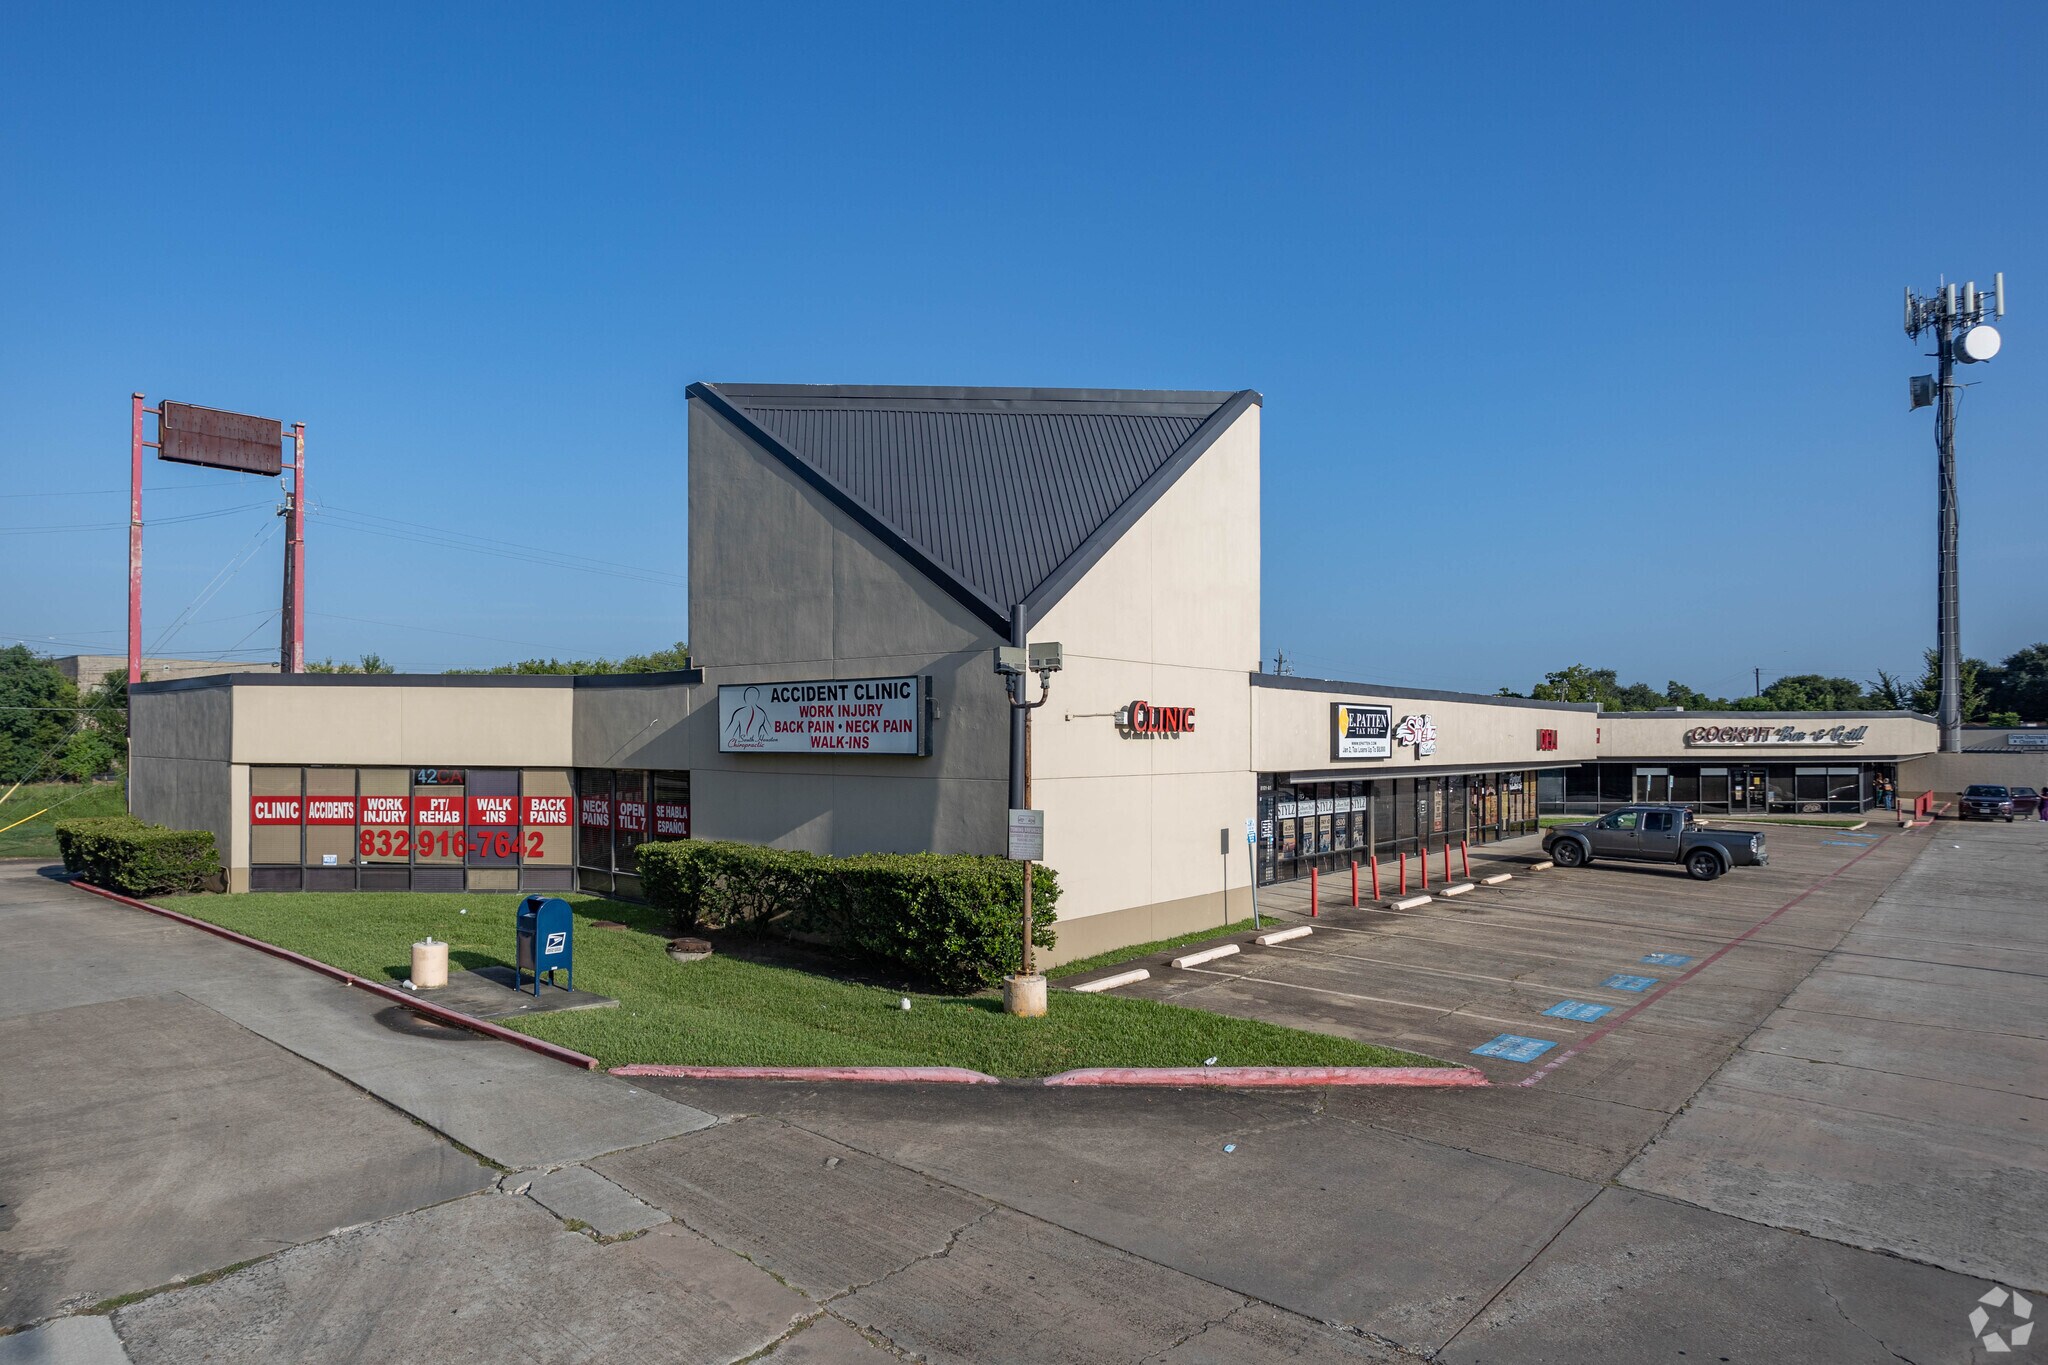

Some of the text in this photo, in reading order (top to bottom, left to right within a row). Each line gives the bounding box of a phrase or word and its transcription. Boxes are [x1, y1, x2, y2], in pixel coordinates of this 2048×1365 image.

[771, 682, 911, 703] ACCIDENT CLINIC
[799, 704, 883, 718] WORK INJURY
[1133, 700, 1195, 732] CLINIC
[774, 719, 912, 733] BACK PAIN NECK PAIN
[1690, 726, 1775, 743] COCKPIT
[728, 738, 765, 750] Chiropractic
[811, 736, 870, 749] WALK-INS
[255, 802, 299, 819] CLINIC
[308, 801, 354, 819] ACCIDENTS
[367, 798, 403, 810] WORK
[430, 799, 449, 811] PT/
[477, 799, 512, 810] WALK
[531, 799, 565, 810] BACK
[583, 800, 609, 813] NECK
[620, 802, 645, 817] OPEN
[363, 811, 407, 823] INJURY
[419, 811, 460, 823] REHAB
[482, 811, 506, 823] -INS
[529, 811, 567, 823] PAINS
[656, 805, 688, 819] SE HABLA
[582, 813, 609, 827] PAINS
[619, 816, 646, 830] TILL 7
[657, 819, 687, 834] ESPAÑOL
[360, 829, 544, 858] 832-916-7642
